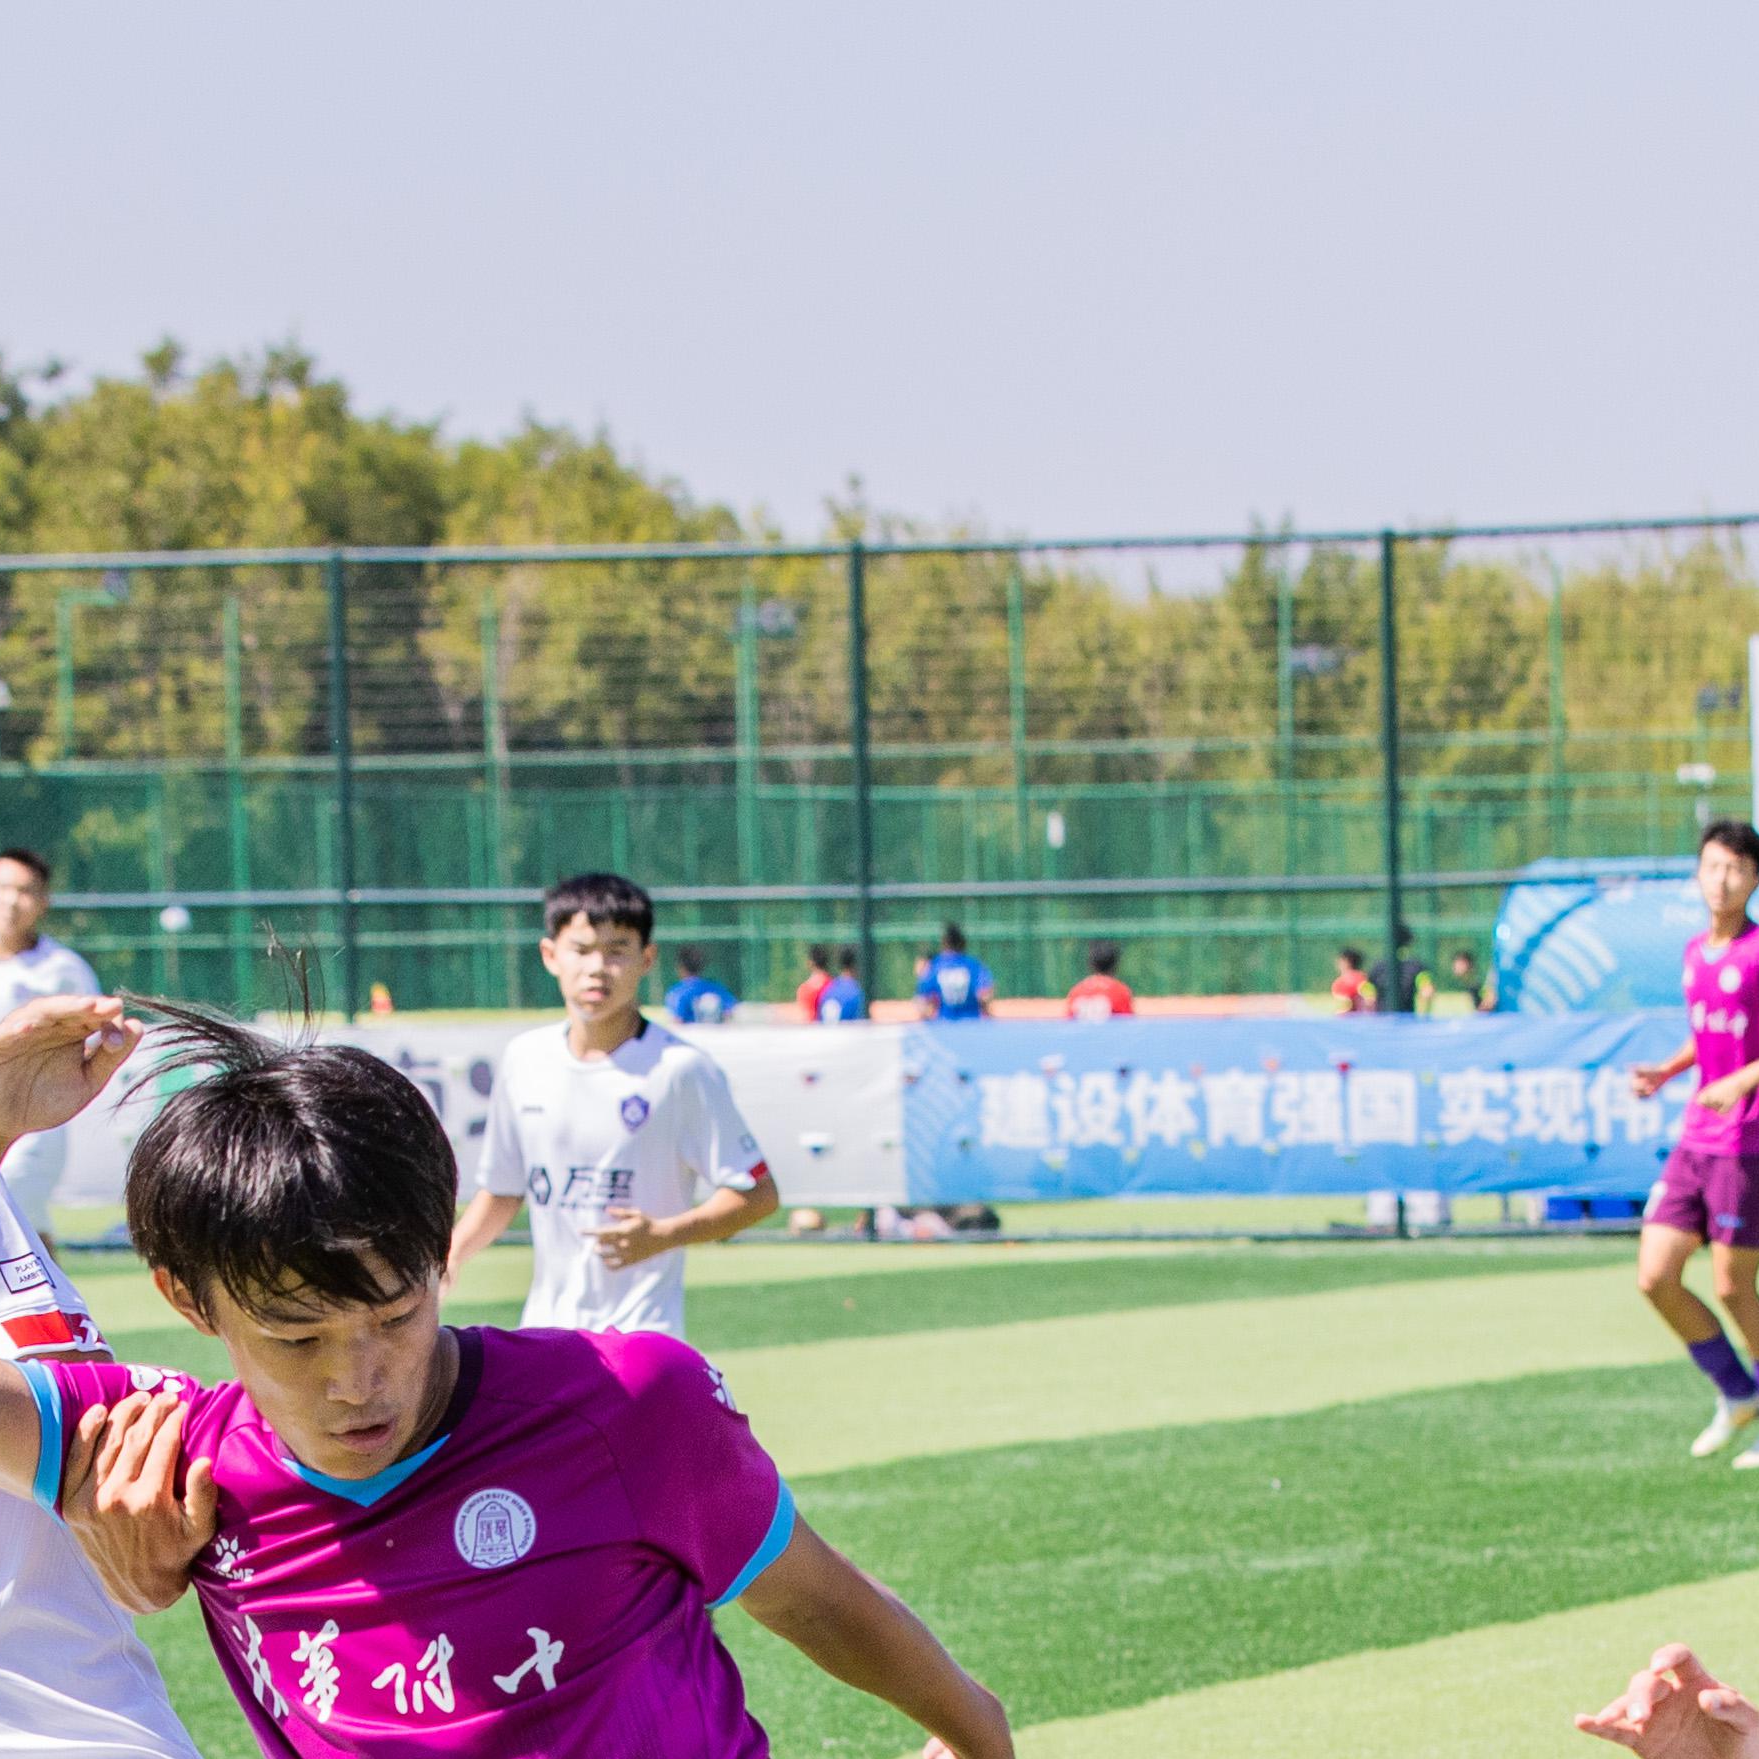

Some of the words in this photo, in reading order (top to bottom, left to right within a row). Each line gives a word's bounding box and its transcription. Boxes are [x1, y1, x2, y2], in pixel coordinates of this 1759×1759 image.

[979, 1068, 1418, 1149] 建设体育强国
